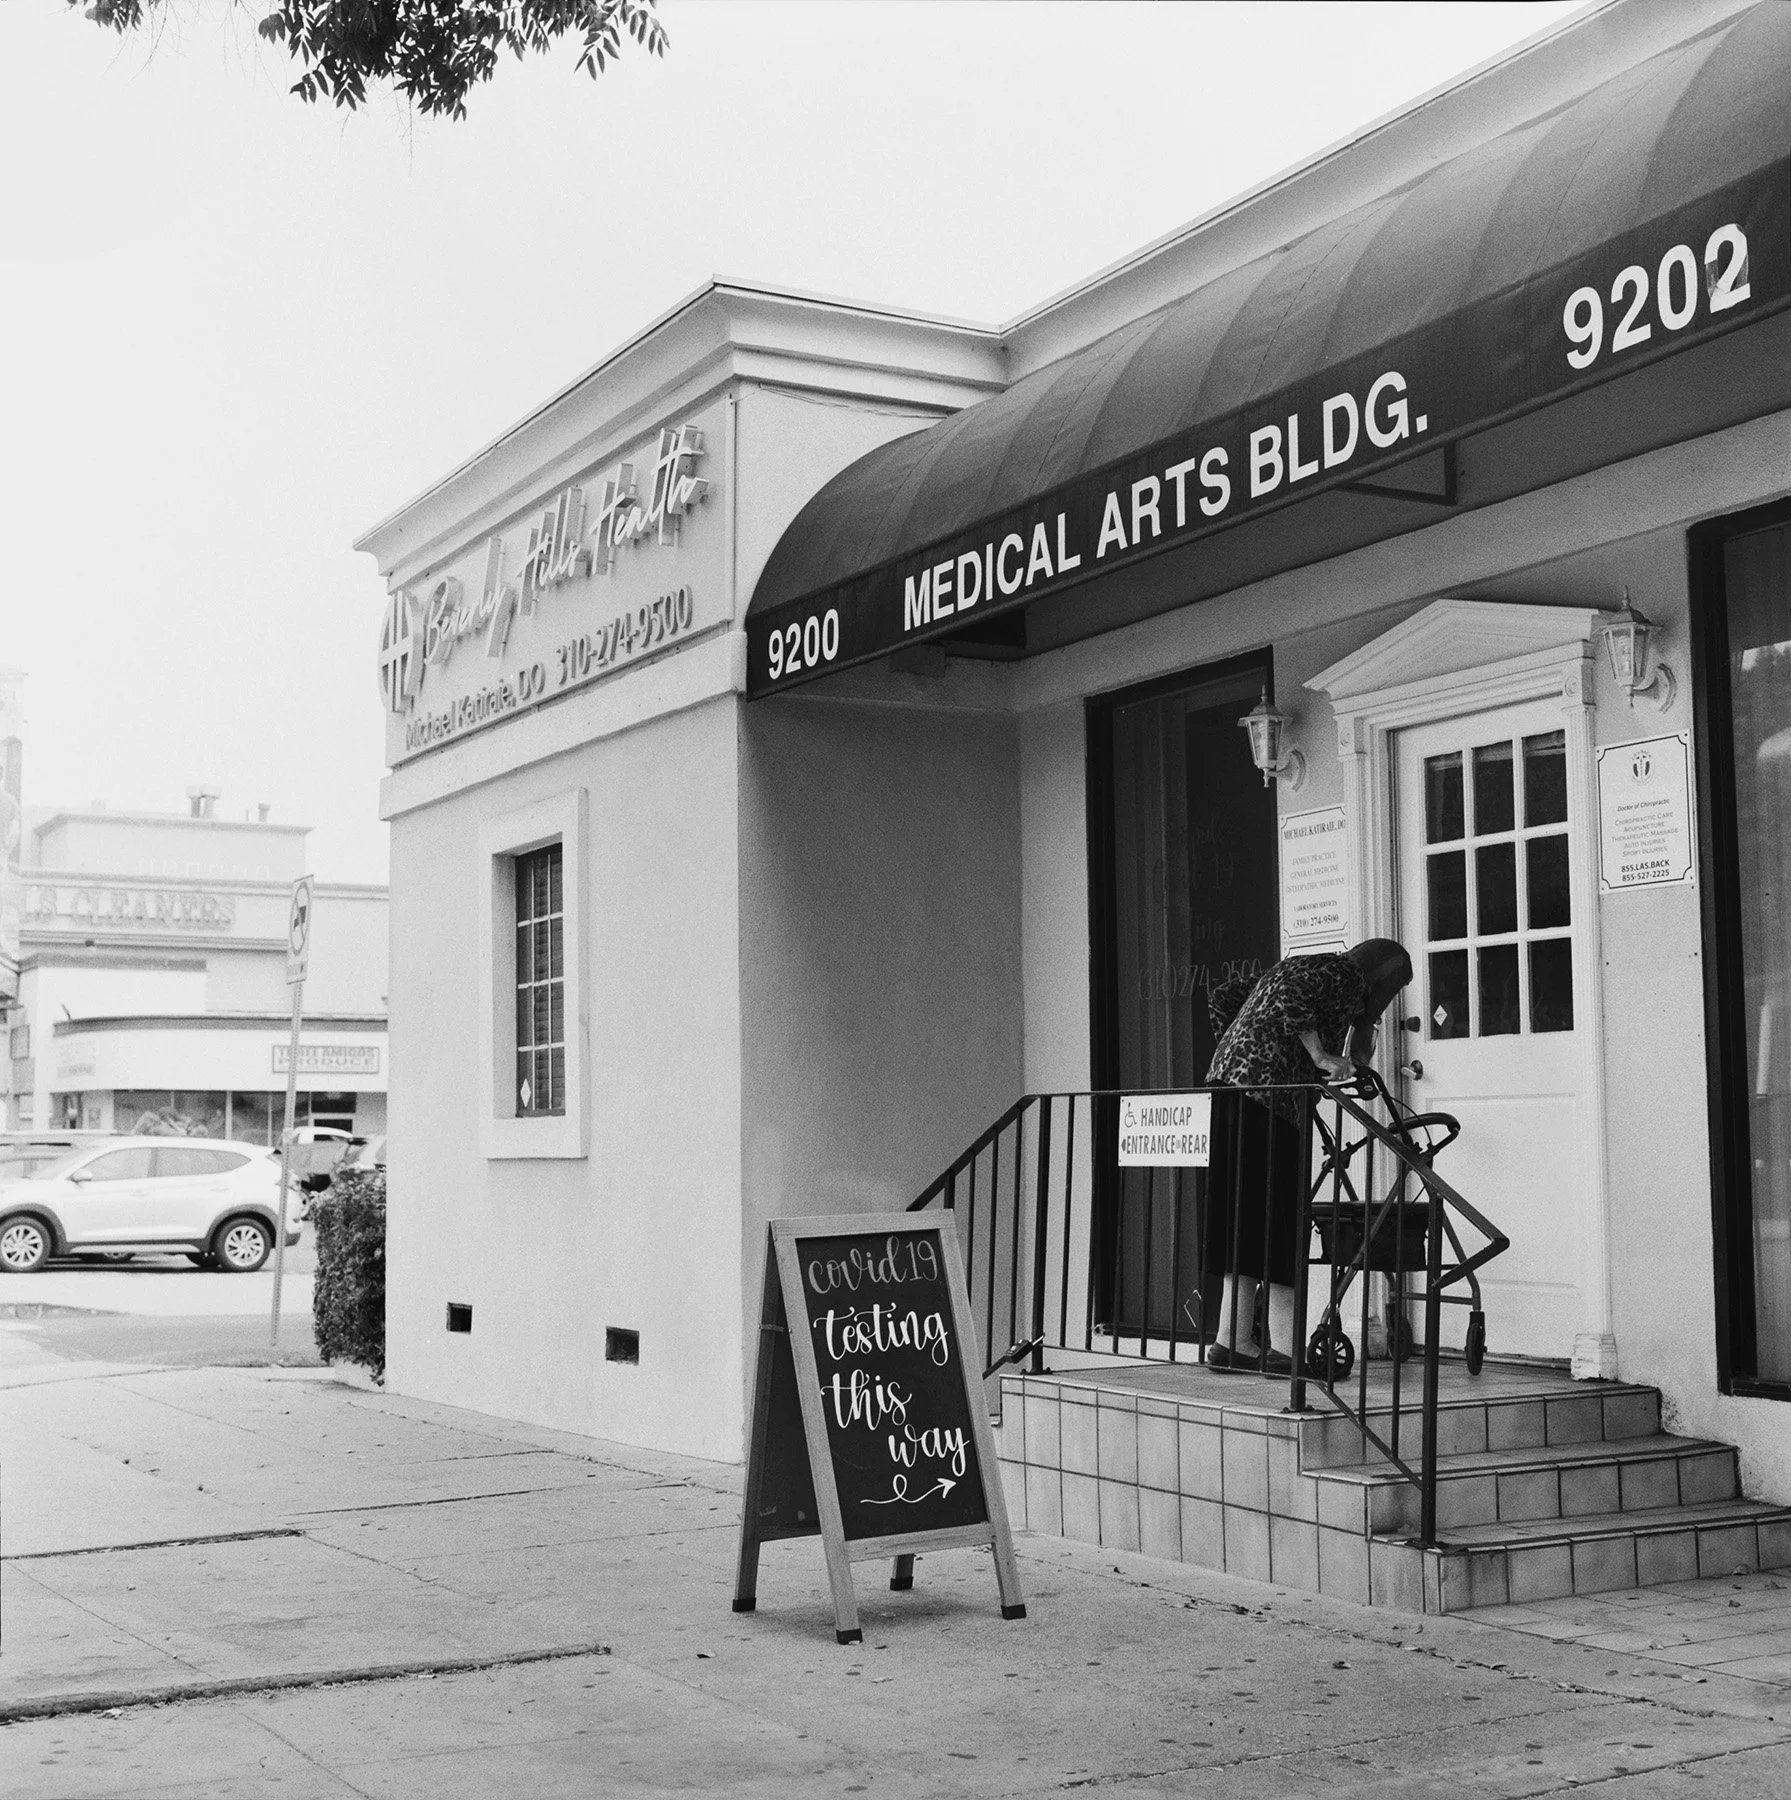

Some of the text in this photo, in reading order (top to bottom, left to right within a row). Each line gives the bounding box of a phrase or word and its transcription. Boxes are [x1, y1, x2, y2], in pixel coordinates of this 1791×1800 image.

[1563, 223, 1751, 369] 9202
[903, 370, 1429, 632] MEDICAL ARTS BLDG.
[423, 423, 710, 663] Beverly Hills Health
[405, 711, 456, 751] Michael
[518, 662, 547, 701] DO
[555, 584, 693, 686] 310-274-9500
[767, 608, 840, 681] 9200
[1617, 804, 1633, 812] Doctor
[1640, 798, 1670, 809] Chiropractic
[1623, 822, 1665, 833] ACUPUNCTURE
[1657, 811, 1674, 820] CARE
[1283, 827, 1309, 840] MICHAEL
[1650, 827, 1678, 838] MASSAGE
[1621, 868, 1670, 882] 855-527-2225
[72, 888, 236, 928] CLEANERS
[1141, 1106, 1193, 1127] HANDICAP
[1126, 1134, 1176, 1155] ENTRANCE
[1181, 1134, 1208, 1155] REAR
[808, 1236, 938, 1294] covid 19
[813, 1302, 948, 1366] testing
[820, 1369, 912, 1431] this
[888, 1423, 970, 1477] way
